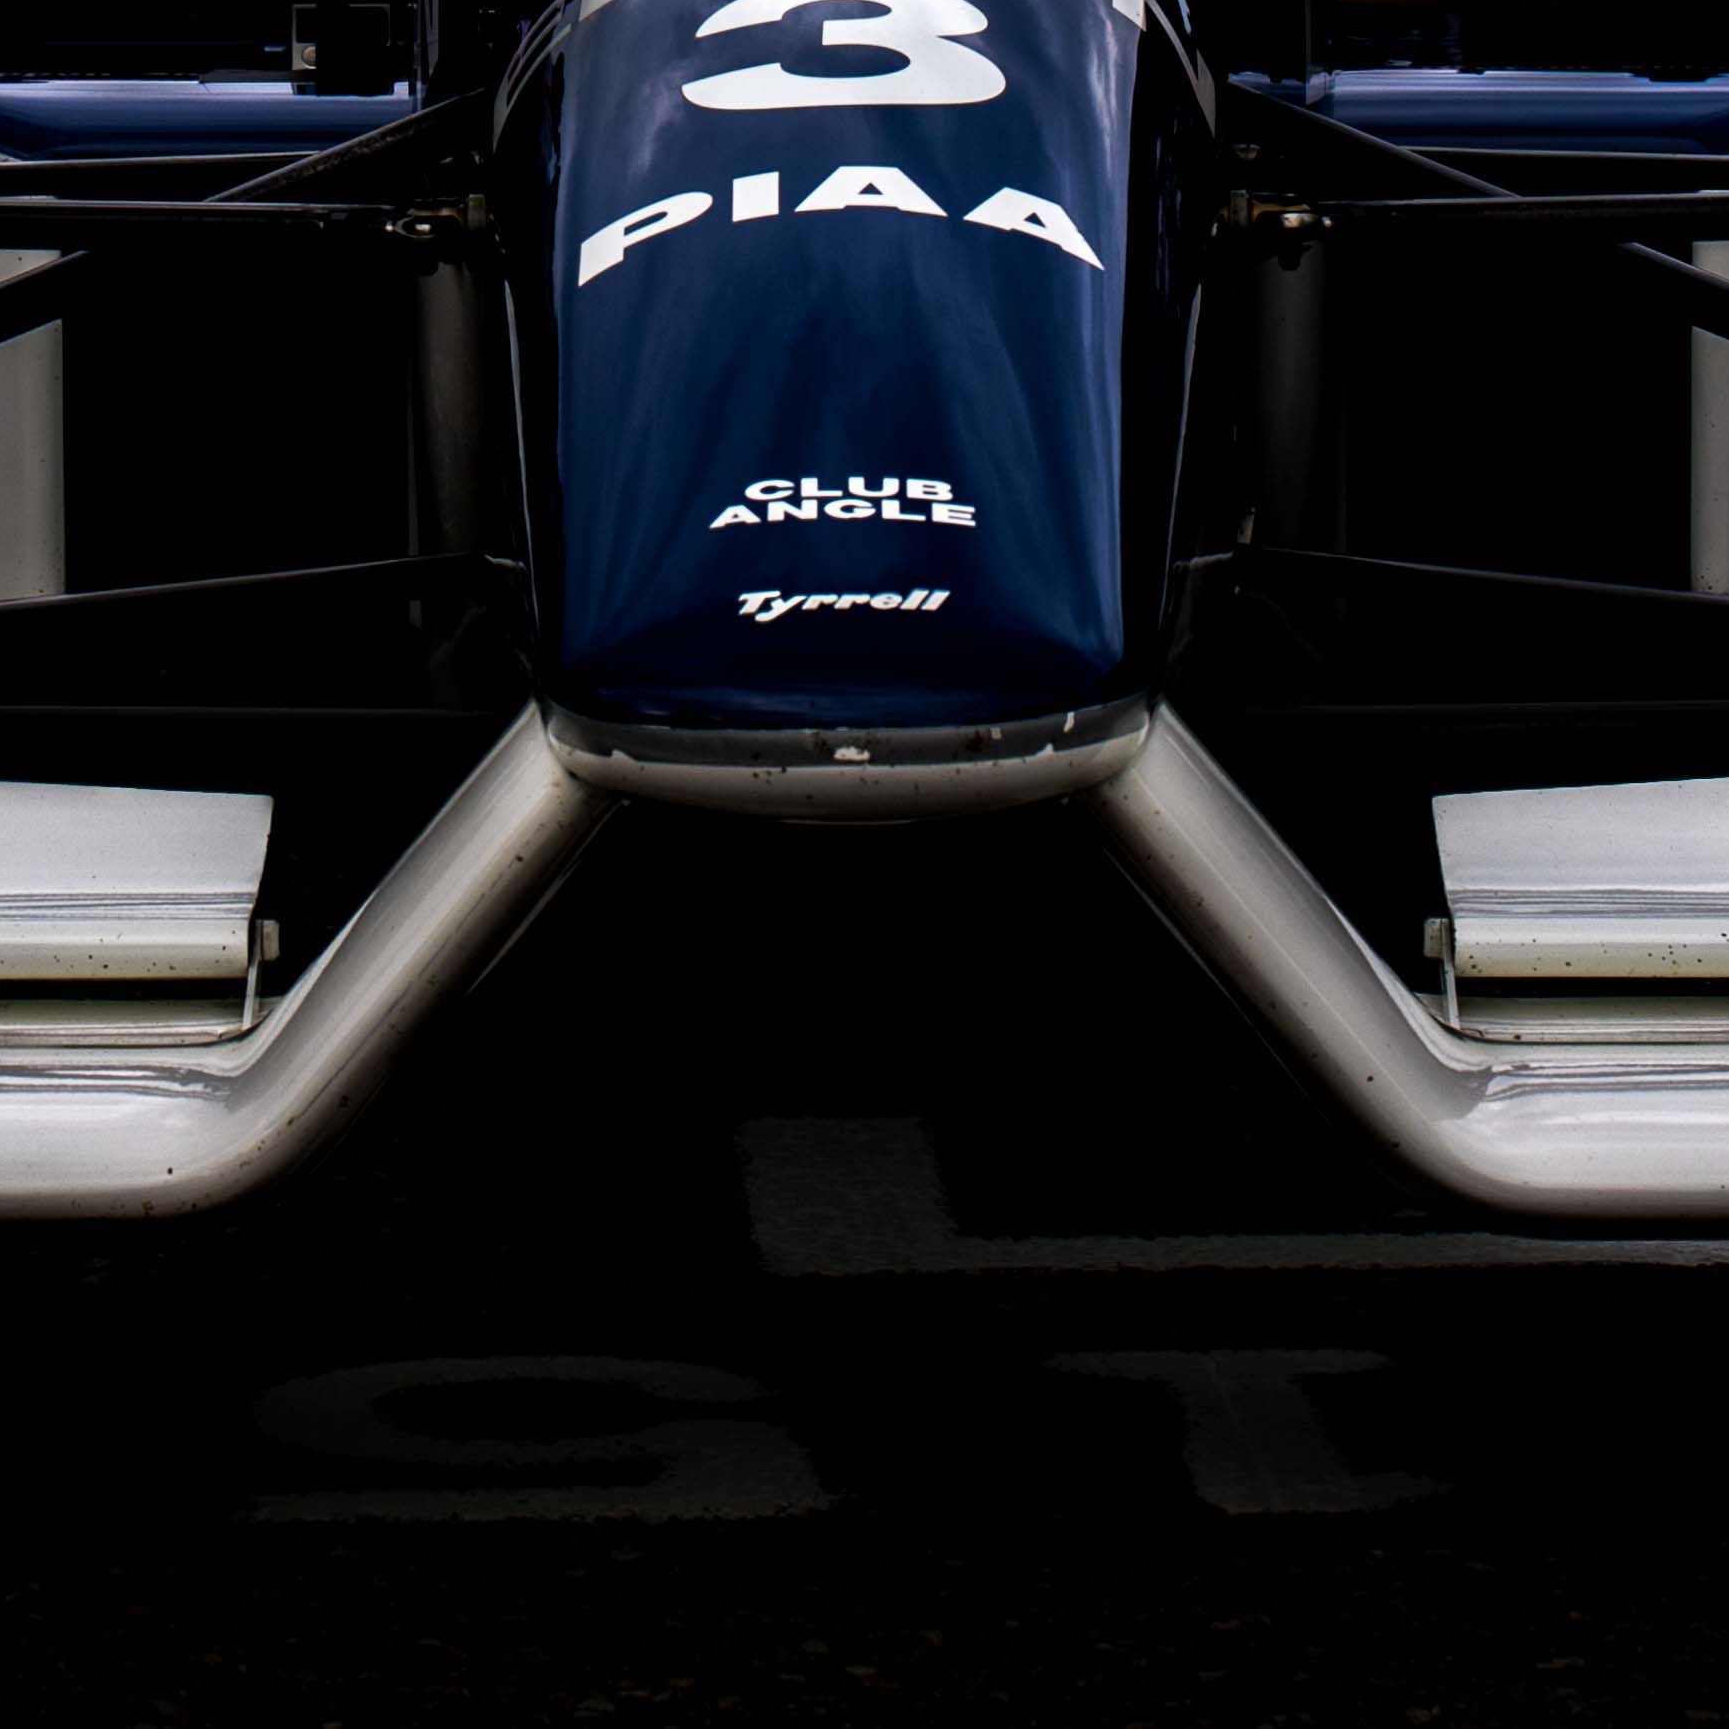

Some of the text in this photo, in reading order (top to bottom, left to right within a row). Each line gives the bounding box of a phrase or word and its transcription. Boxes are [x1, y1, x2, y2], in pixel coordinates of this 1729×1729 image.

[578, 166, 1106, 286] PIAA
[744, 476, 953, 501] CLUB
[709, 499, 976, 529] ANGLE
[738, 589, 951, 622] Tyrrell
